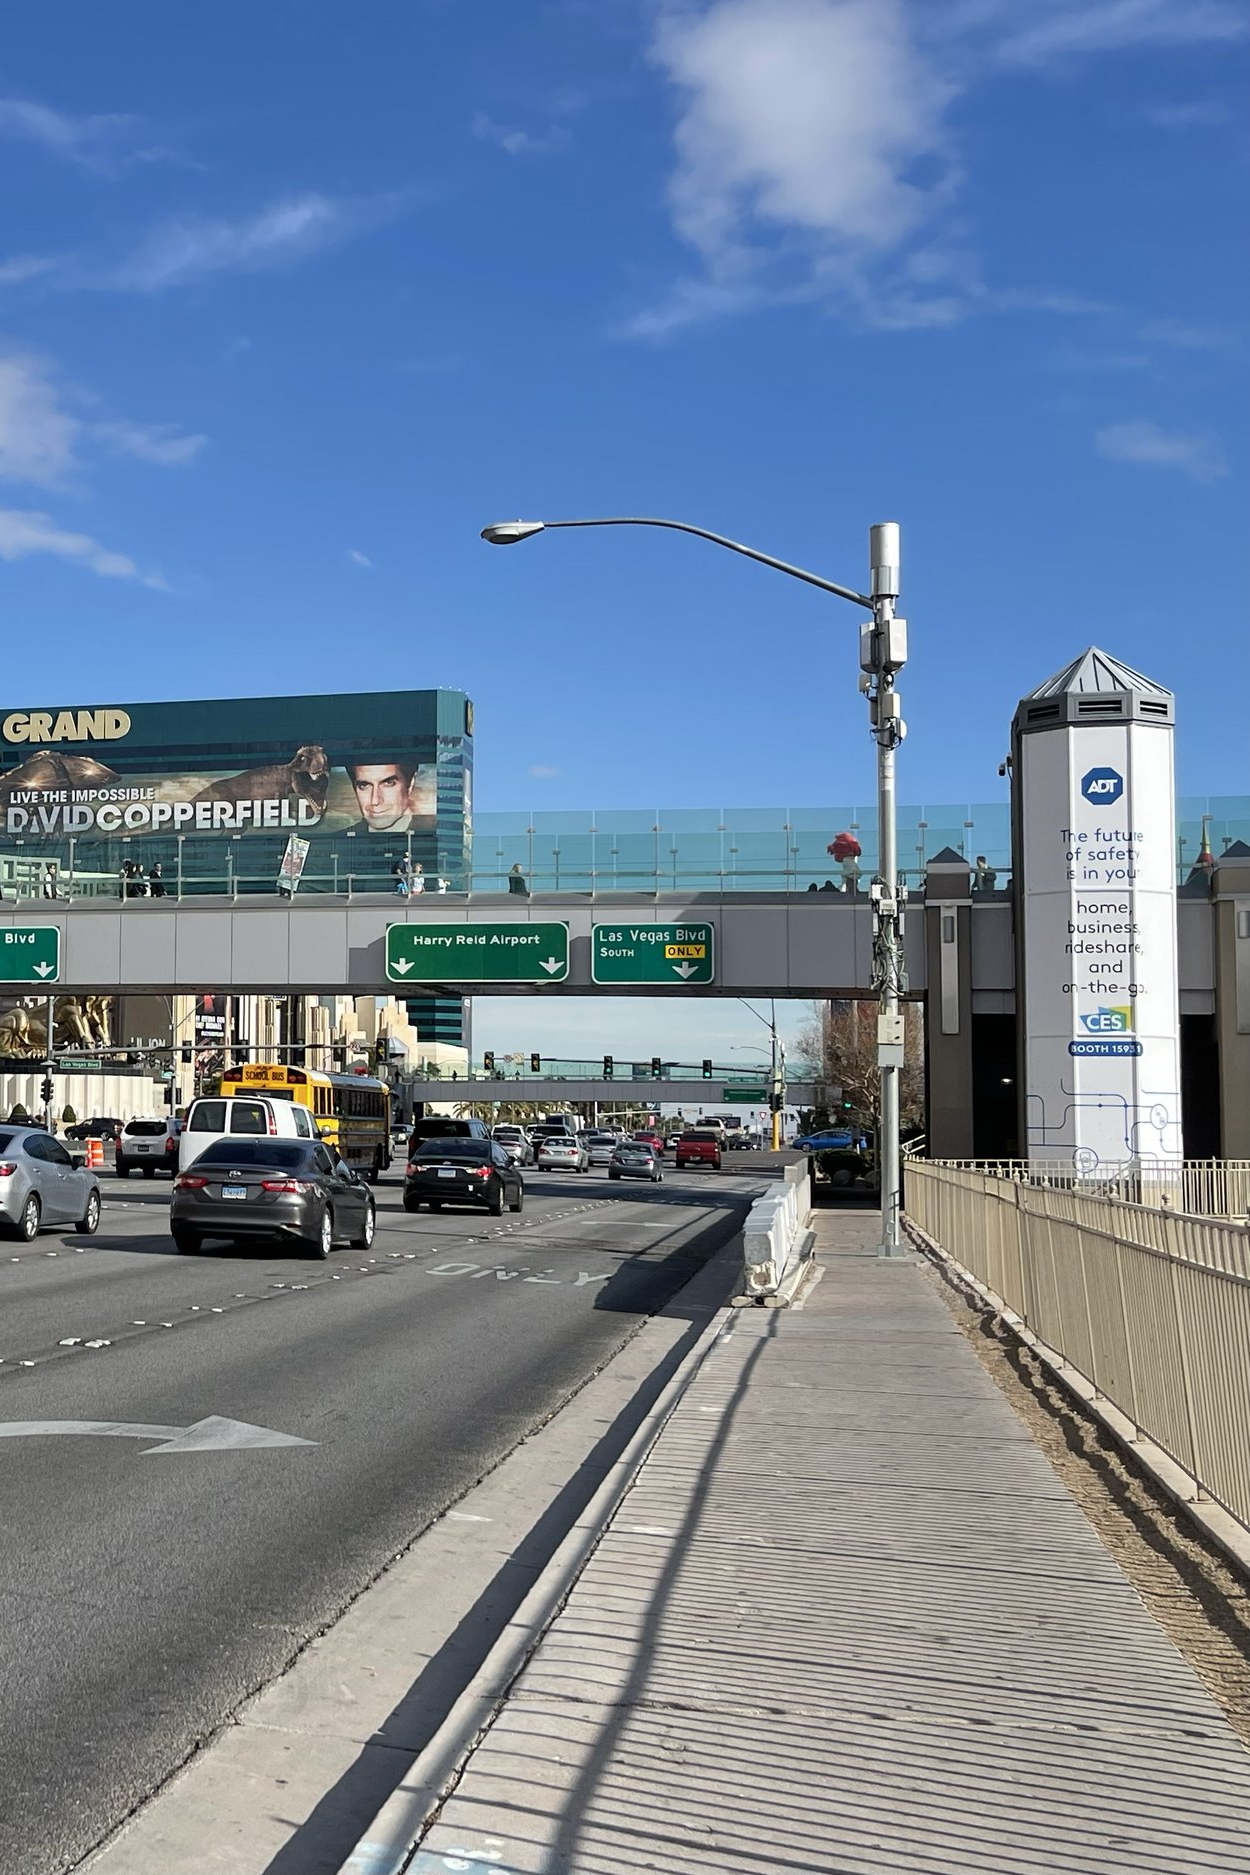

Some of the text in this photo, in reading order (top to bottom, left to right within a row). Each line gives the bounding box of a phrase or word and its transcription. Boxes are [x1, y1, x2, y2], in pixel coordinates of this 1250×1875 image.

[3, 708, 132, 744] GRAND
[1086, 778, 1118, 794] ADT
[10, 787, 155, 804] LIVE THE IMPOSSIBLE
[1060, 828, 1144, 843] The future
[1065, 846, 1140, 865] of safety
[1066, 866, 1076, 880] is
[1083, 866, 1098, 879] in
[1077, 900, 1133, 916] home,
[1067, 920, 1141, 935] business,
[5, 933, 36, 944] Blvd
[413, 934, 540, 947] Harry Reid Airport
[600, 929, 706, 945] Las Vegas Blvd
[600, 947, 703, 958] SOUTH ONLY
[1065, 940, 1143, 956] rideshare,
[1089, 960, 1122, 973] and
[1086, 1015, 1123, 1030] CES
[1072, 1043, 1141, 1053] BOOTH 15931
[245, 1071, 285, 1081] SCHOOL BUS
[426, 1263, 612, 1286] ONLY
